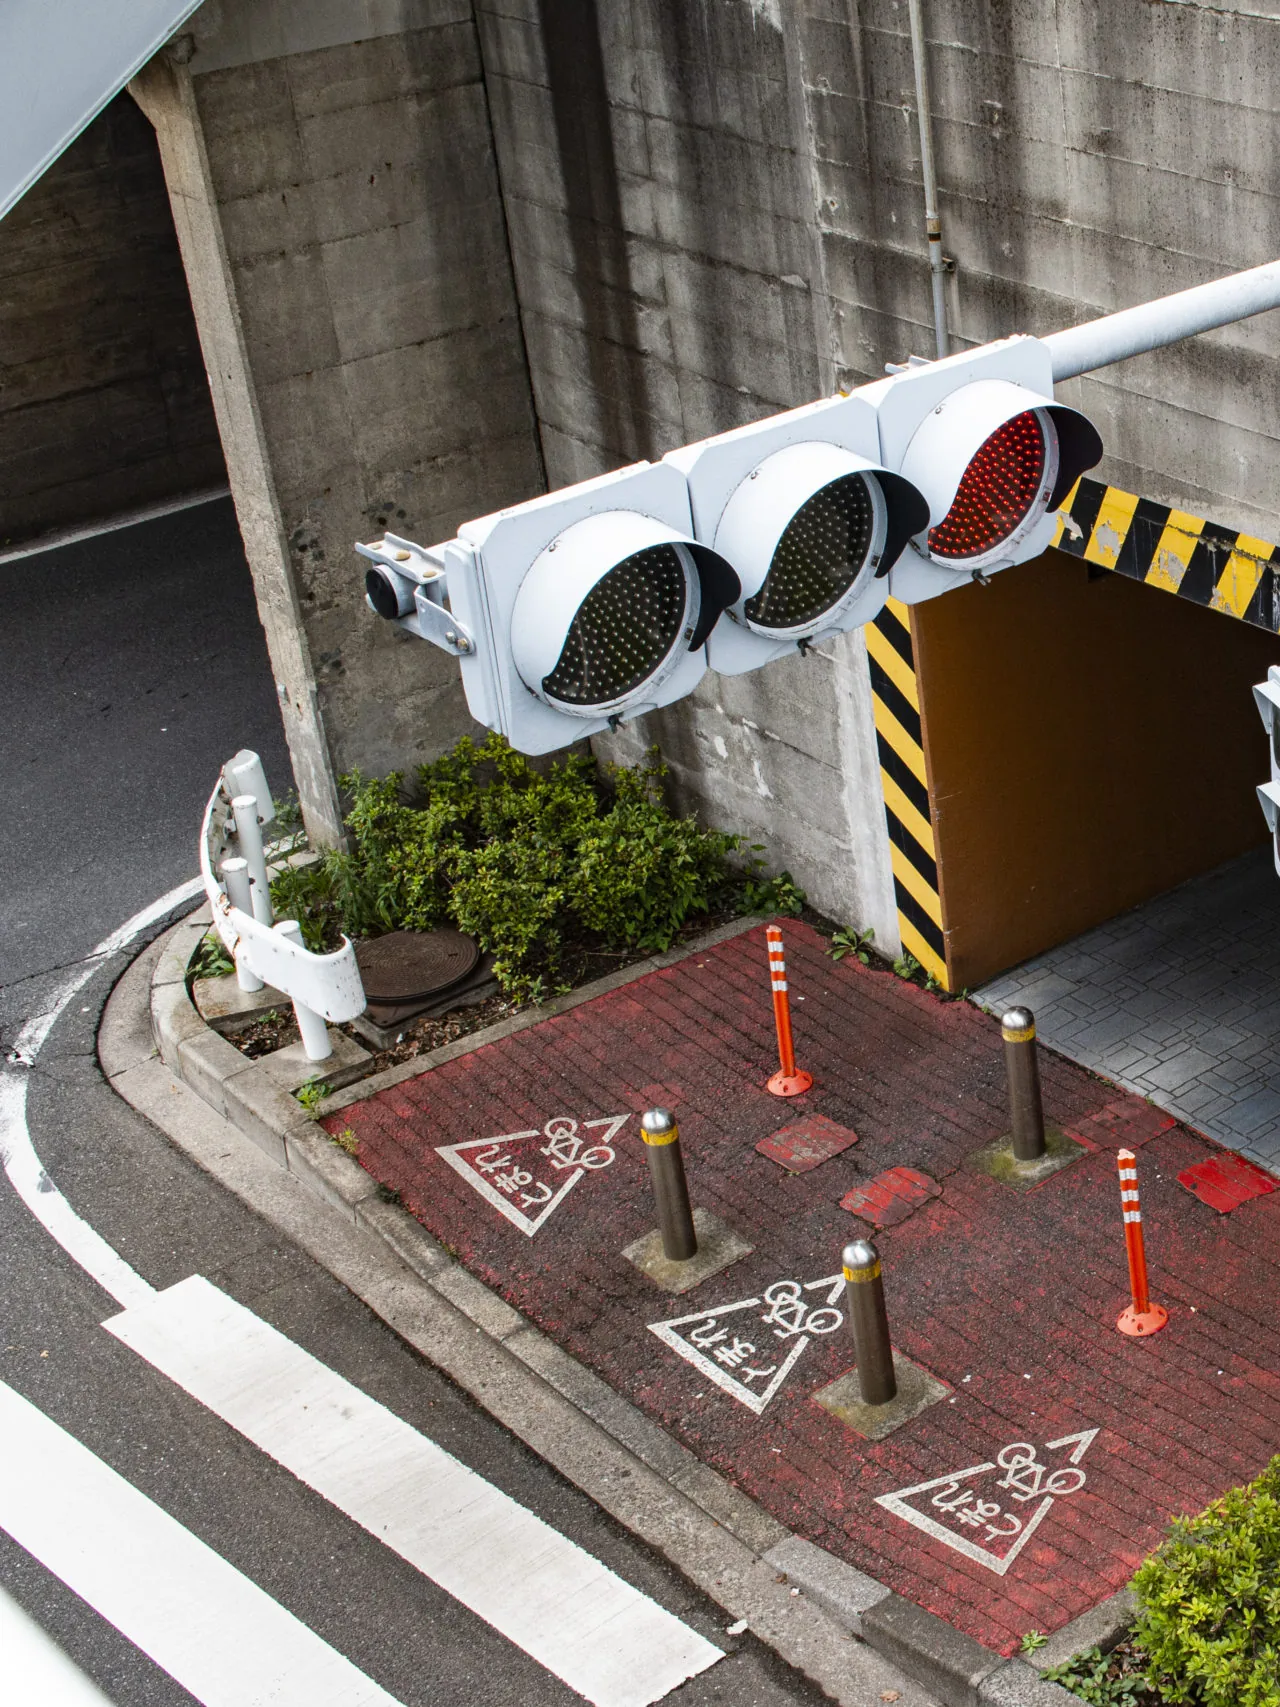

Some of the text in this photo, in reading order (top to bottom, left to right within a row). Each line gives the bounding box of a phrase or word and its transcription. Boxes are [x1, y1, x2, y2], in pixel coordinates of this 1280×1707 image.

[475, 1144, 553, 1209] とまれ
[931, 1482, 1023, 1541] とまれ
